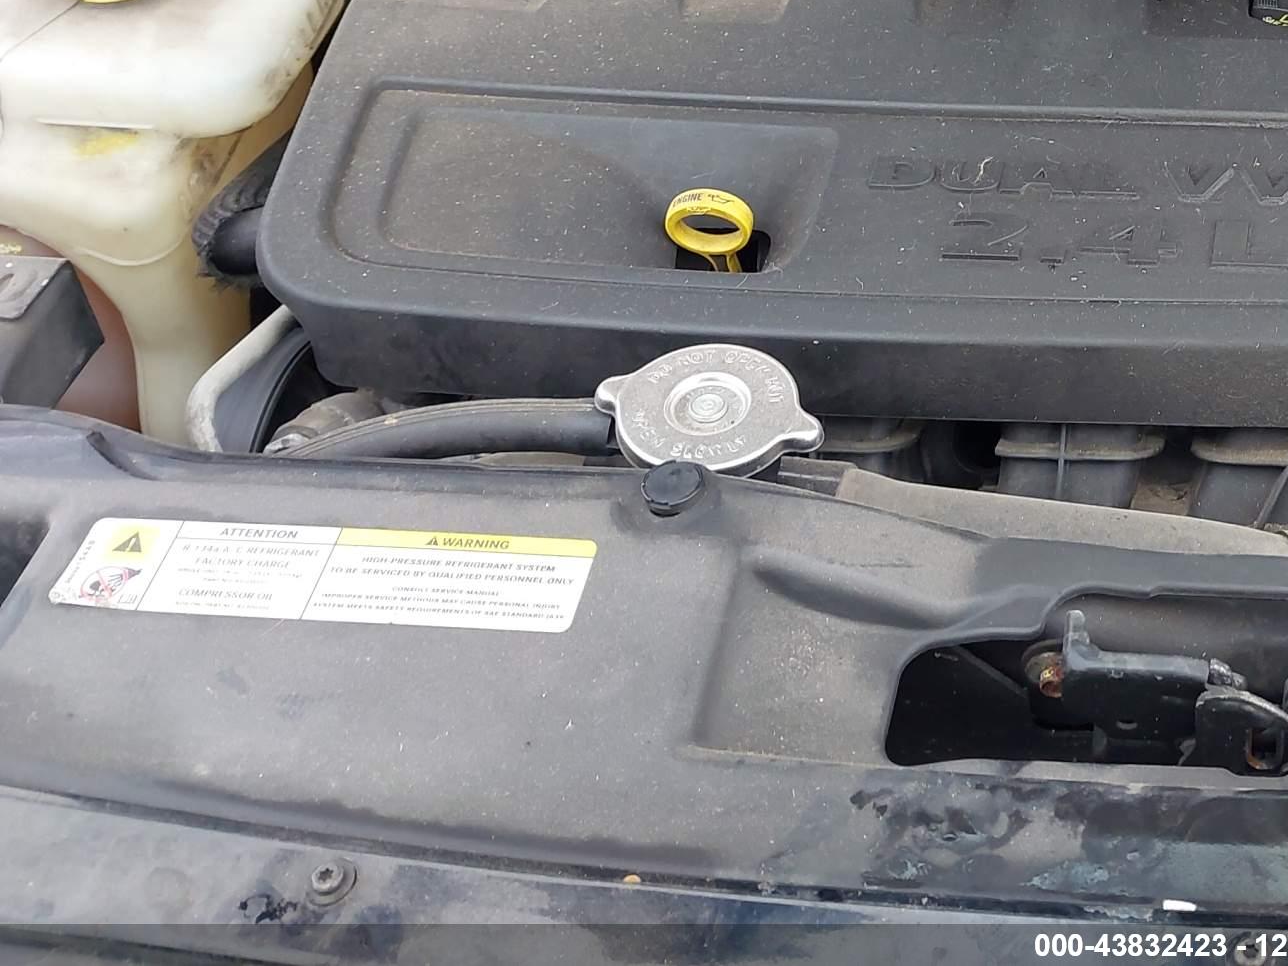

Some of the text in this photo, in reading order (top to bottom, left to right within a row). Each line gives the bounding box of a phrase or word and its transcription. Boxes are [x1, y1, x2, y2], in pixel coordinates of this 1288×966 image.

[867, 156, 1142, 203] DUAL
[220, 528, 299, 539] ATTENTION
[442, 537, 511, 550] WARNING
[246, 545, 321, 557] REFRIGERANT
[194, 557, 291, 569] FACTORY CHARGE
[444, 559, 514, 571] REFRIGERANT
[515, 563, 556, 573] SYSTEM
[361, 568, 411, 577] SERVICED
[413, 570, 425, 578] BY
[428, 571, 482, 581] QUALIFIED
[484, 574, 544, 584] PERSONNEL
[546, 577, 576, 586] ONLY
[178, 588, 274, 601] COMPRESSOR OIL
